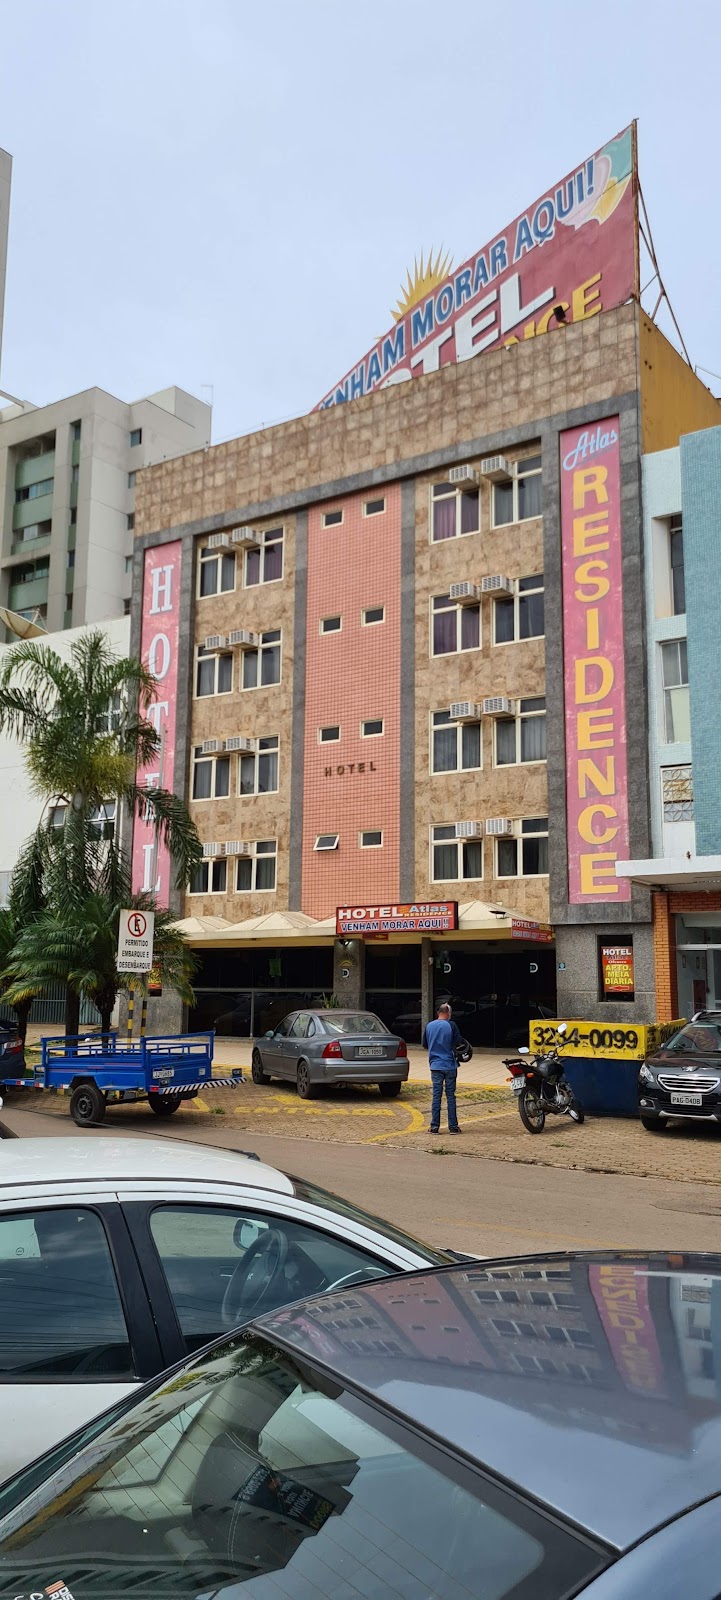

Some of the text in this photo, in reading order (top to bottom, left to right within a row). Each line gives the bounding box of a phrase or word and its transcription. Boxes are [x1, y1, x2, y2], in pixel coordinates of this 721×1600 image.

[411, 235, 508, 348] MORAR
[513, 154, 596, 264] AQUI!
[562, 426, 619, 472] Atlas
[572, 464, 619, 896] RESIDENCE
[324, 761, 377, 777] HOTEL
[338, 904, 448, 920] HOTEL Atlas
[341, 921, 380, 932] VENHAM
[381, 919, 415, 930] MORAR
[418, 918, 441, 929] AQUI
[512, 920, 531, 928] HOTEL
[125, 939, 149, 947] PERMITIDO
[121, 950, 146, 958] EMBARQUE
[602, 948, 632, 956] HOTEL
[118, 960, 151, 970] DESEMBARQUE
[234, 1106, 396, 1117] ENTRADA
